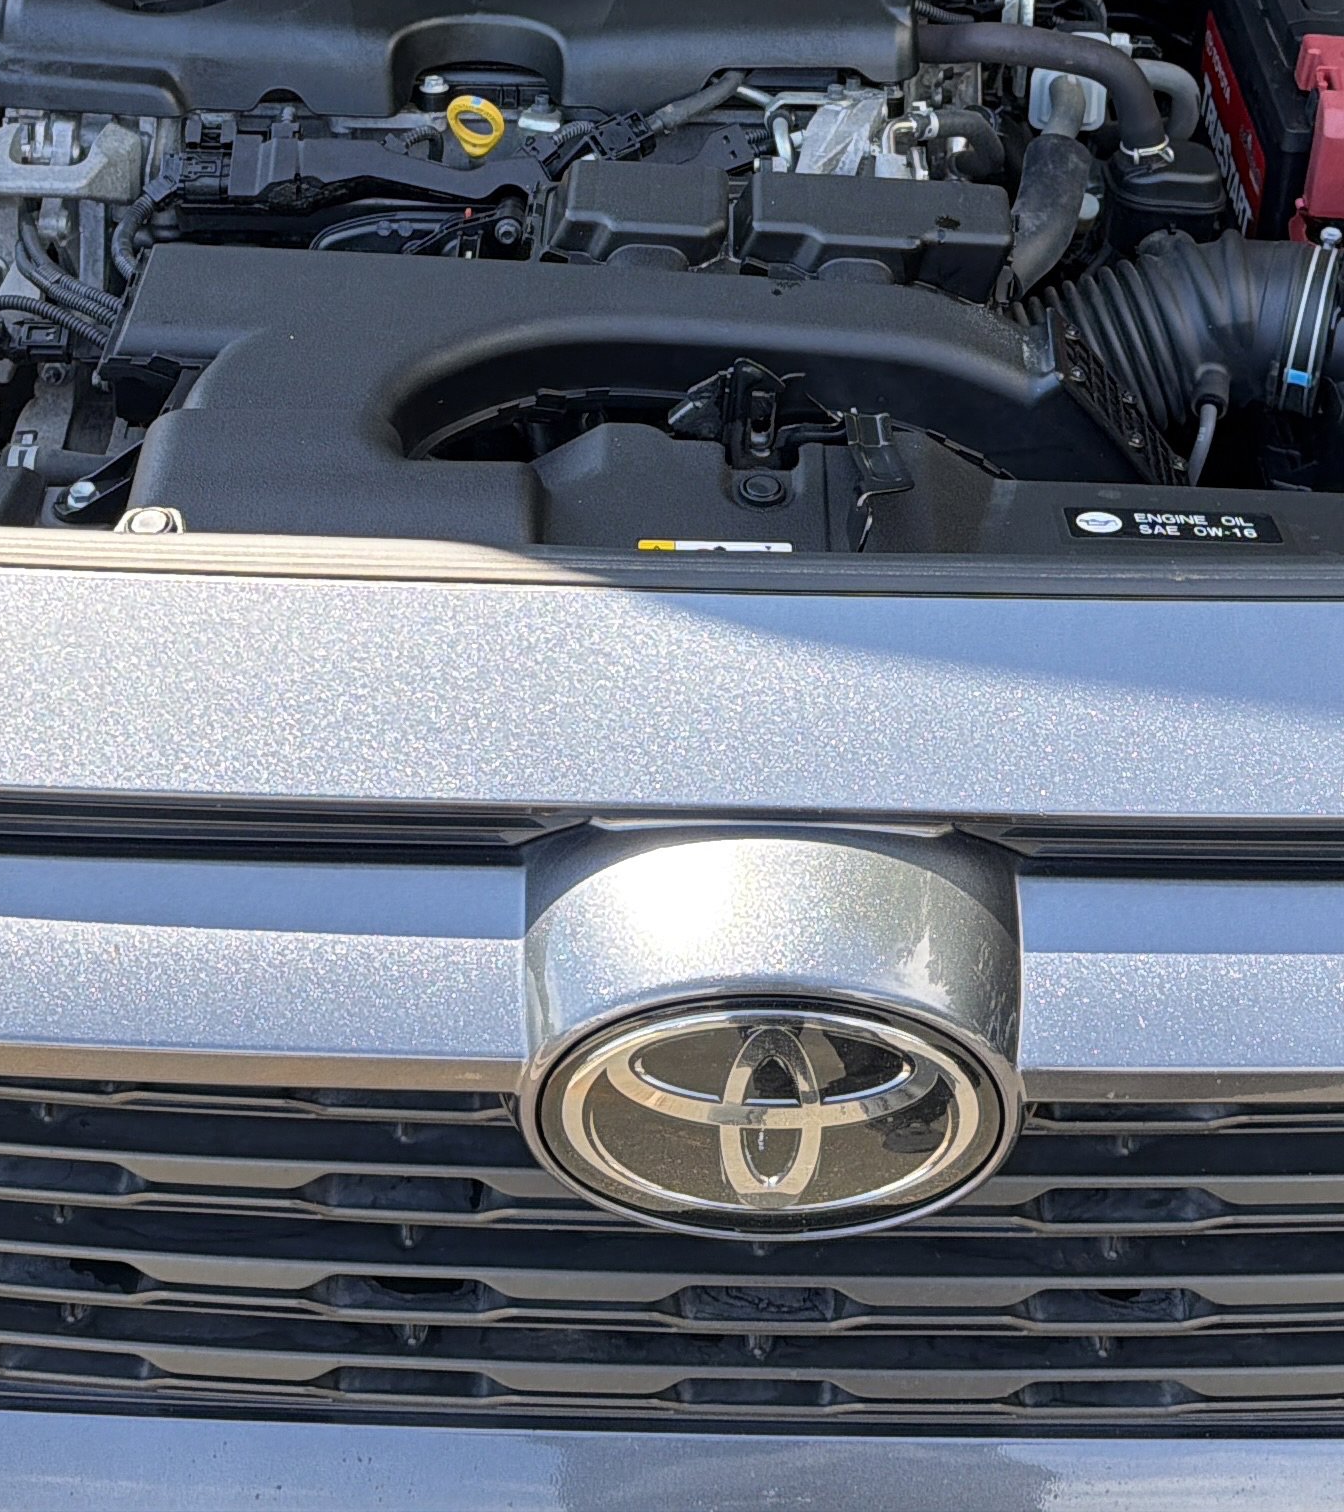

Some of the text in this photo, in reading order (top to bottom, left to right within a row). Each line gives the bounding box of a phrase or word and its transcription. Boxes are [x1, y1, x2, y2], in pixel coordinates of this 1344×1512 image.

[1133, 513, 1254, 527] ENGINE OIL
[1138, 524, 1258, 539] SAE 0W-16
